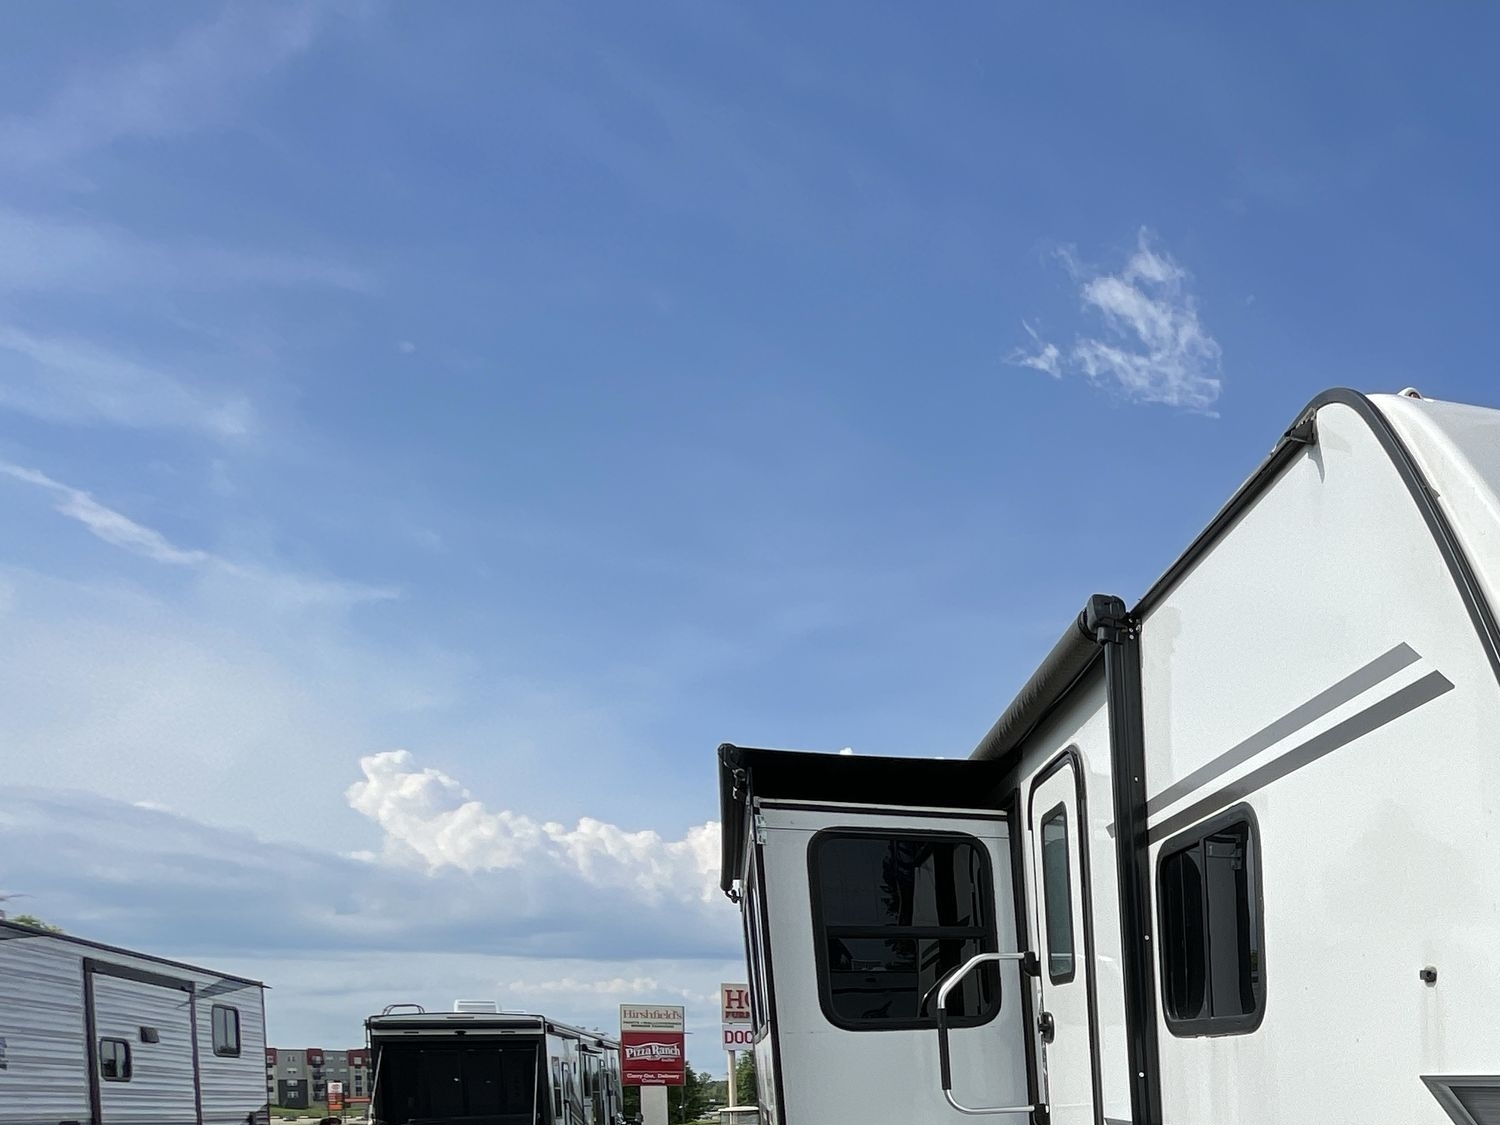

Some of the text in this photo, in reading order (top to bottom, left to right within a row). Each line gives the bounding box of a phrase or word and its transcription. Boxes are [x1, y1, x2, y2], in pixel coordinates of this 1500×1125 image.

[725, 989, 749, 1009] H
[623, 1009, 682, 1019] Hirshfield's
[625, 1045, 681, 1058] Pizza Ranch
